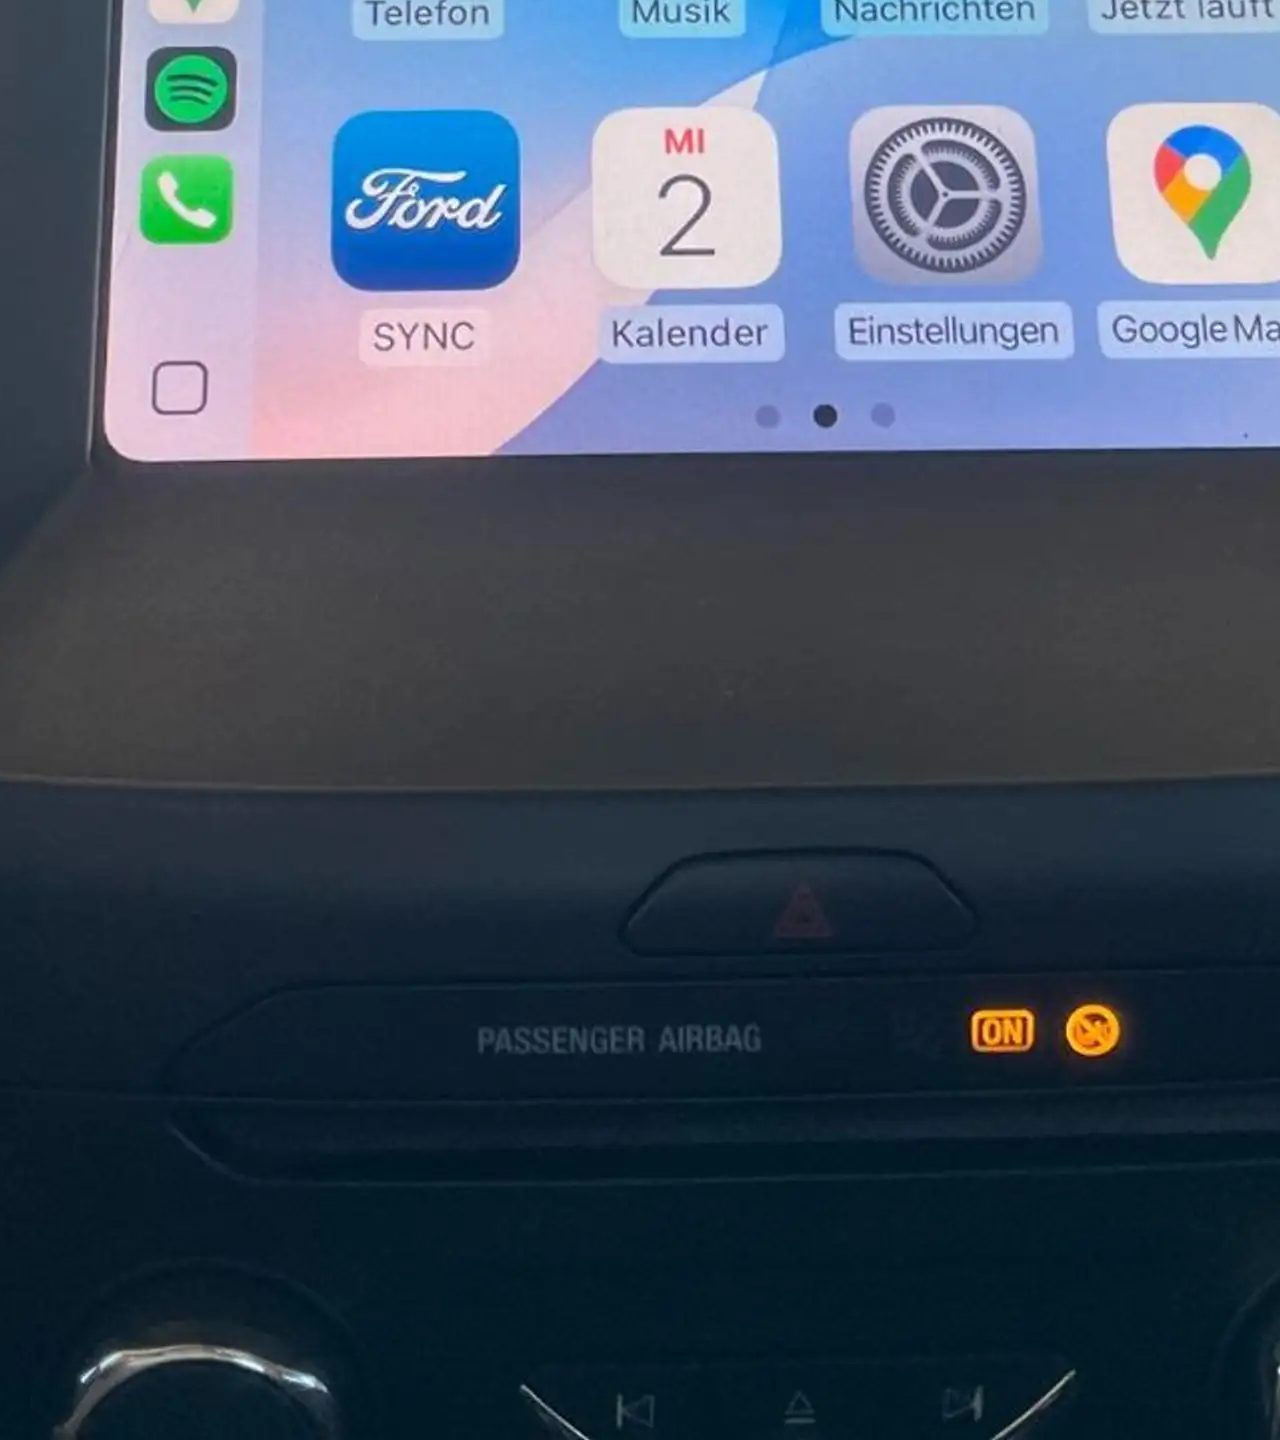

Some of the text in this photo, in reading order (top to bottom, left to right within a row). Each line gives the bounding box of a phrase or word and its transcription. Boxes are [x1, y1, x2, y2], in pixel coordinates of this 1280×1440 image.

[664, 128, 705, 154] MI
[345, 167, 507, 231] Ford
[658, 174, 716, 257] 2
[373, 321, 476, 352] SYNC
[612, 319, 769, 348] Kalender
[849, 317, 1059, 349] Einstellungen
[1112, 314, 1227, 348] Google
[477, 1023, 762, 1055] PASSENGER AIRBAG
[982, 1018, 1023, 1046] ON
